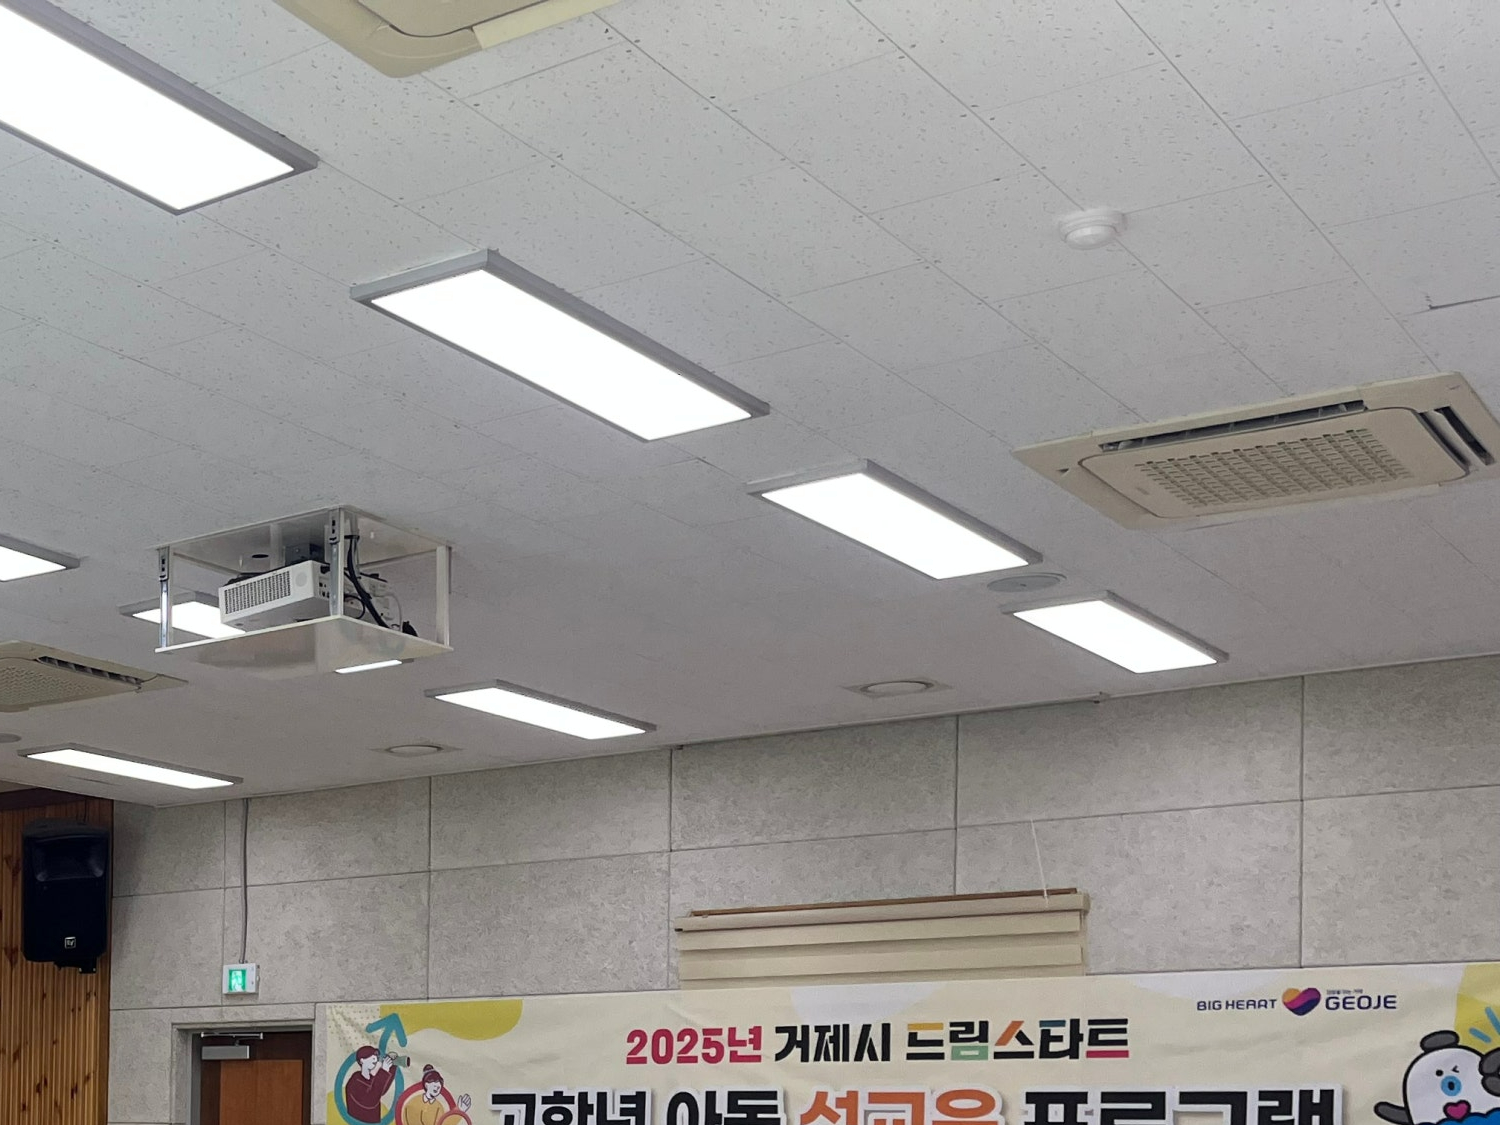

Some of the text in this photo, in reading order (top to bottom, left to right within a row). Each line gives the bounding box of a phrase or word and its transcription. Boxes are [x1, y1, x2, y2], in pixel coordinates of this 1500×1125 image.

[1196, 998, 1278, 1011] BIG HEART
[1325, 994, 1397, 1011] GEOJE
[626, 1018, 1129, 1065] 2025년 거제시 드림스타트
